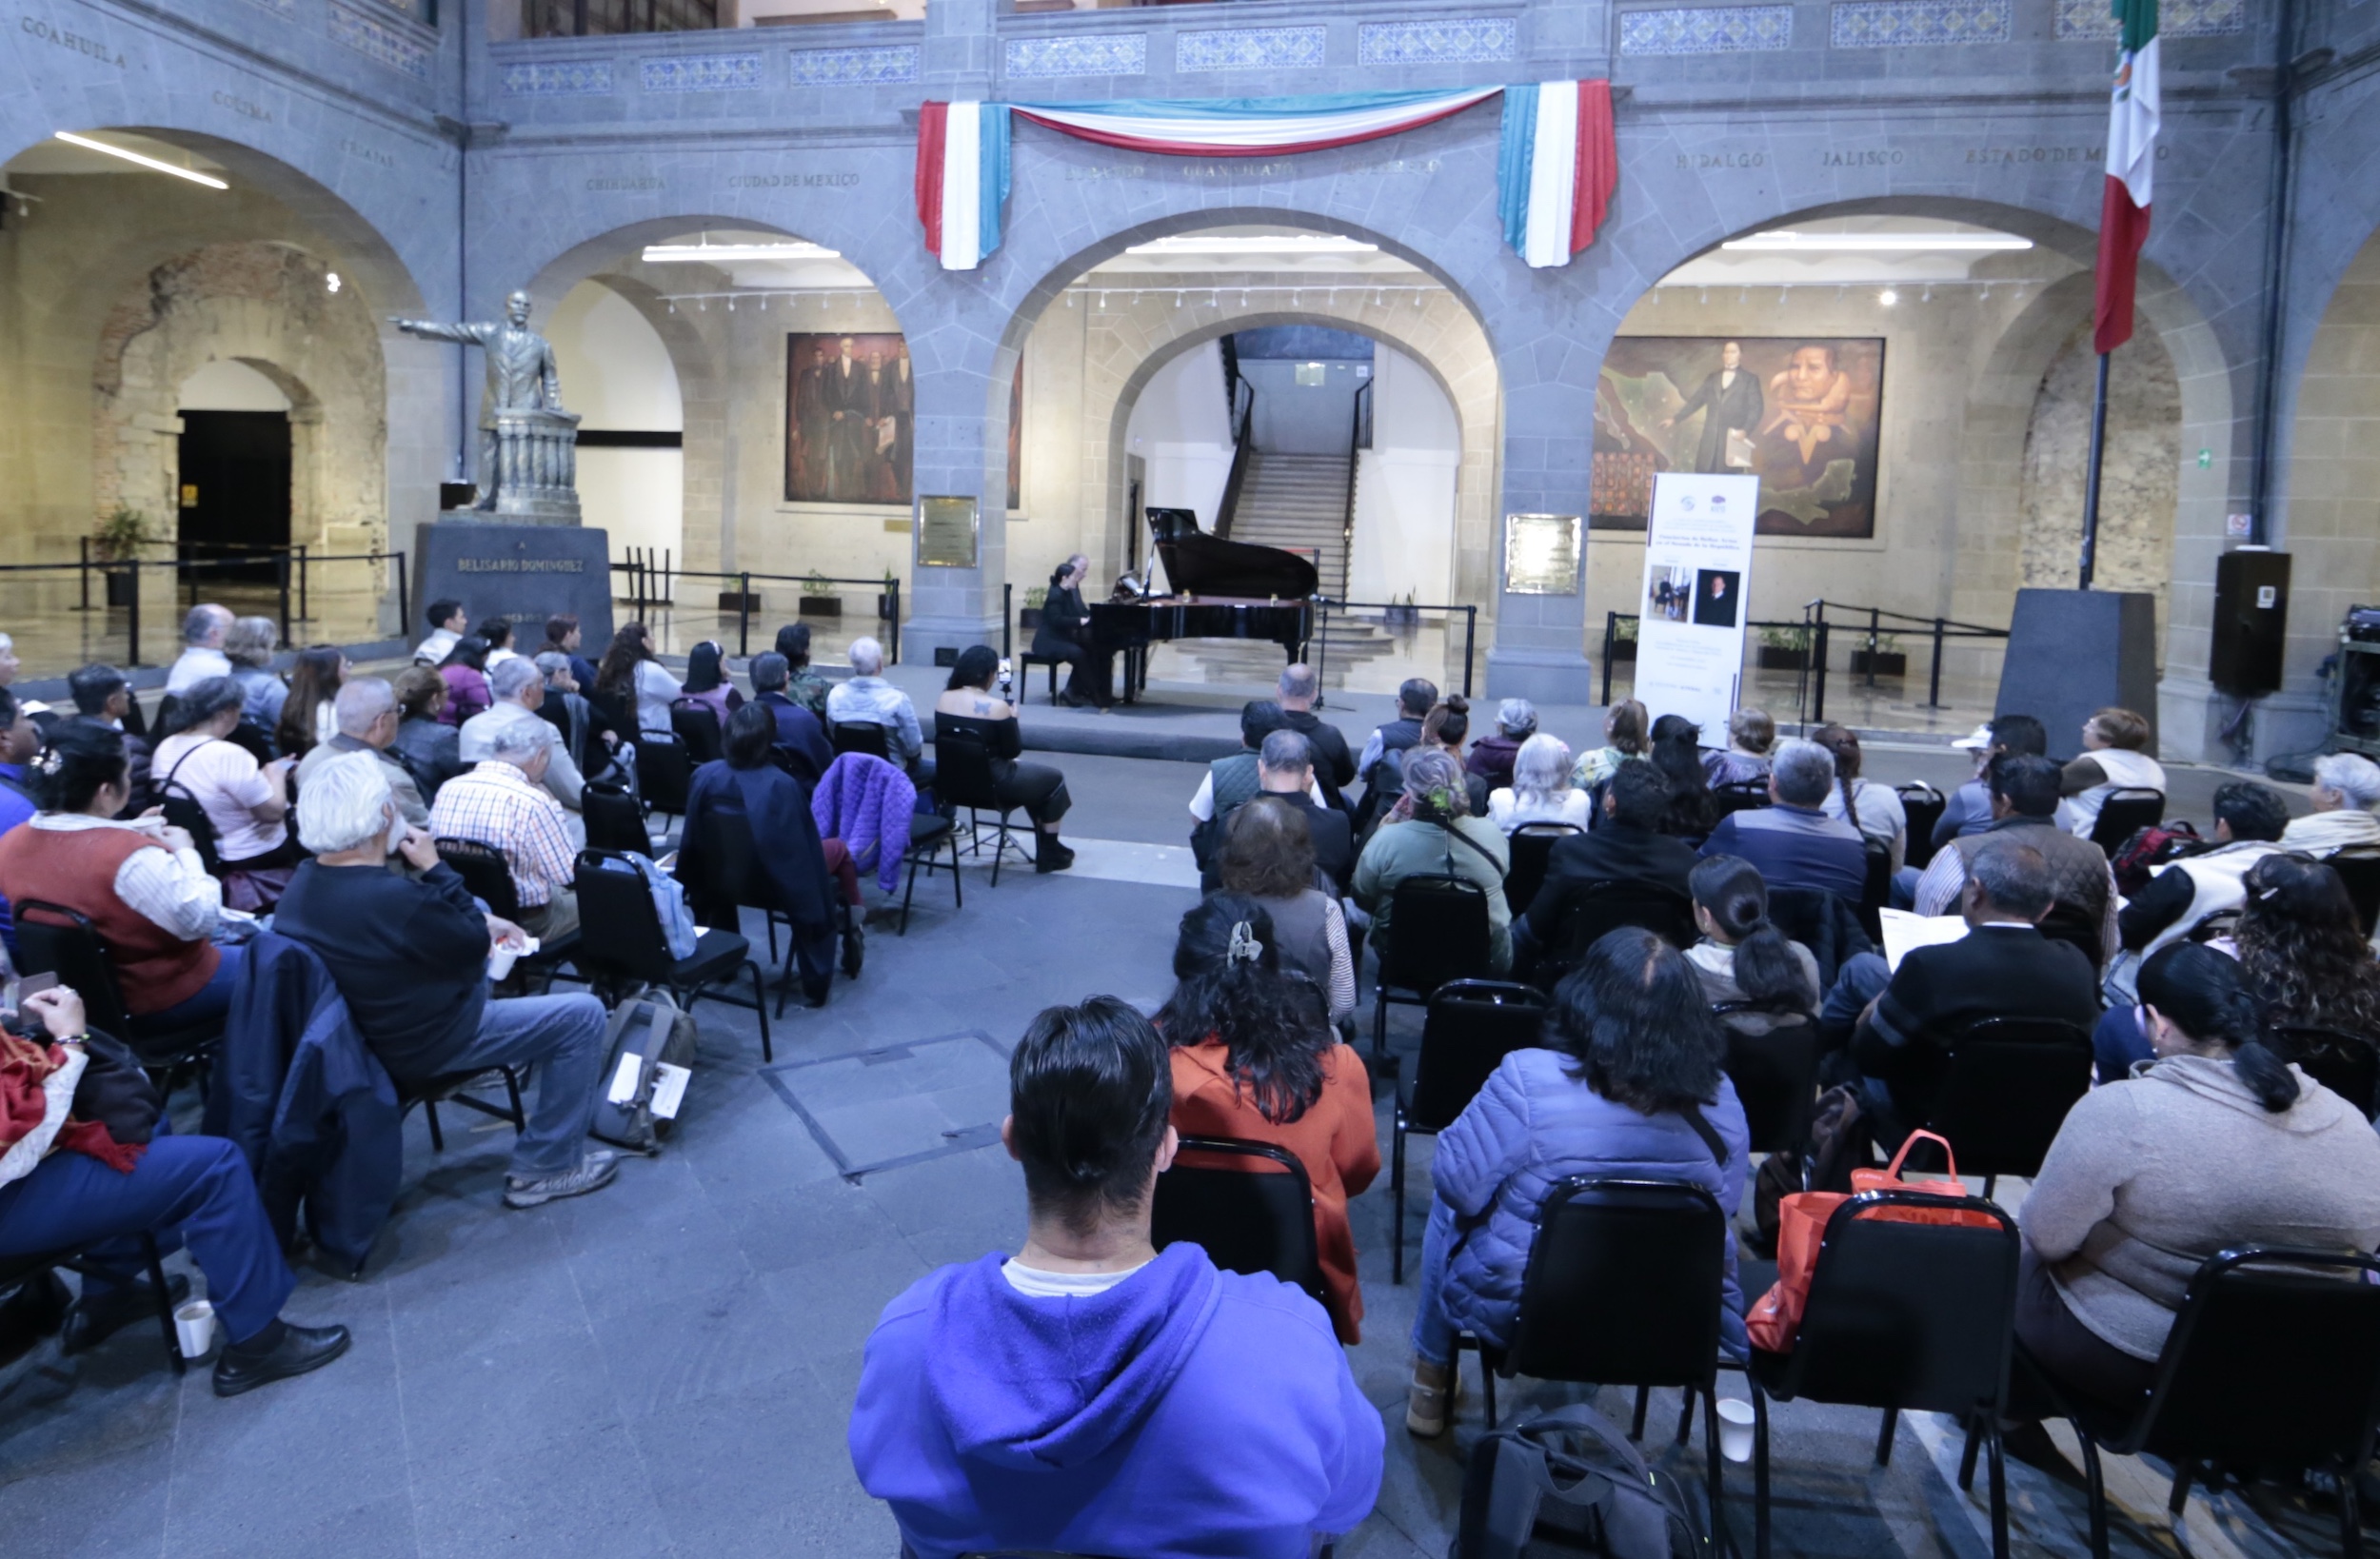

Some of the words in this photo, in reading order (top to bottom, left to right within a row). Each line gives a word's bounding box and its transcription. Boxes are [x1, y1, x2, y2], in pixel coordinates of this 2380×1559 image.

[21, 16, 127, 69] COAHUILA
[1676, 152, 1764, 168] HIDALGO
[1822, 150, 1904, 167] JALISCO
[1965, 148, 2046, 163] ESTADO
[2052, 148, 2077, 162] DE
[585, 176, 665, 191] CHIHUAHUA
[728, 174, 781, 188] CIUDAD
[783, 173, 801, 187] DE
[803, 172, 860, 187] MEXICO
[518, 542, 526, 550] A
[458, 557, 520, 572] BELISARIO
